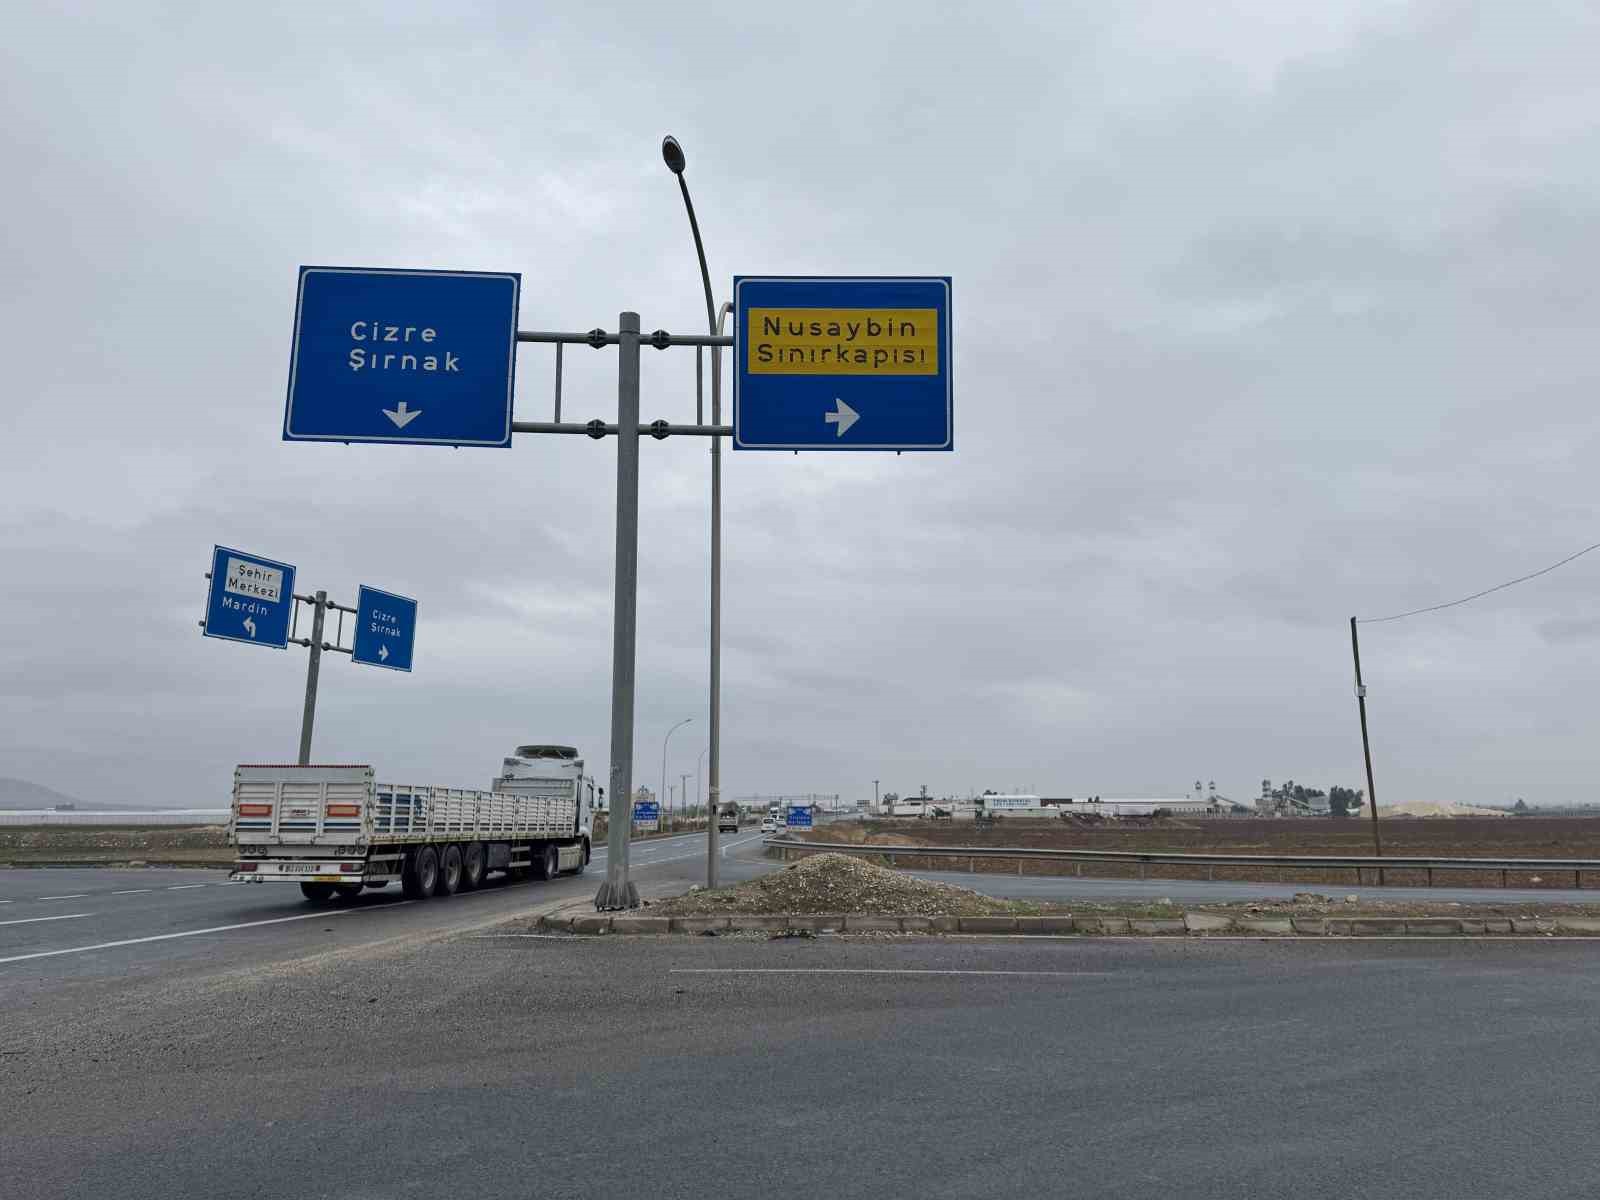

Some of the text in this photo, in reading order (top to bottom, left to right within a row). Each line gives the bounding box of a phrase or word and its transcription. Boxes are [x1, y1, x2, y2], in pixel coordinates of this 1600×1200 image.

[350, 321, 437, 343] Cizre
[763, 316, 916, 341] Nusaybin
[349, 348, 460, 371] Şırnak
[757, 343, 926, 369] Sınırkapısı
[238, 564, 273, 582] Şehir
[228, 577, 279, 598] Merkezi
[222, 596, 268, 616] Mardin
[372, 608, 397, 624] Cizre
